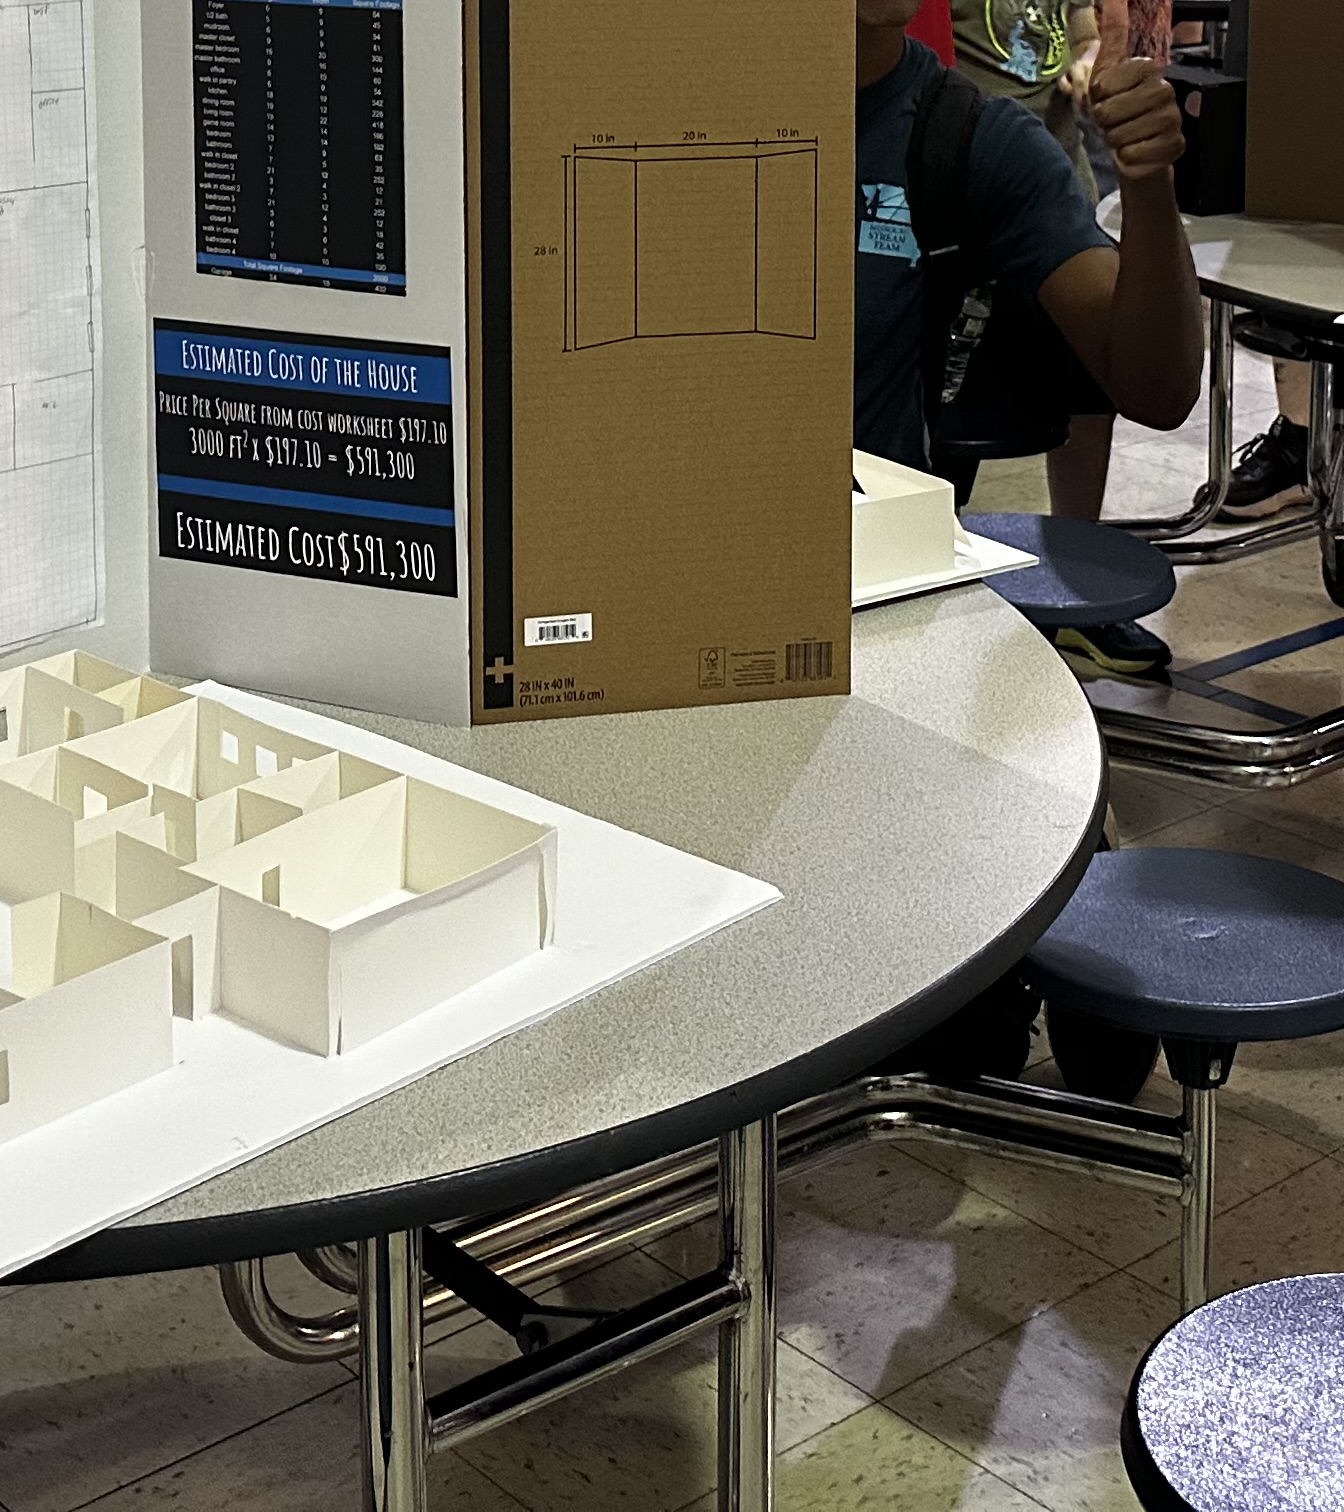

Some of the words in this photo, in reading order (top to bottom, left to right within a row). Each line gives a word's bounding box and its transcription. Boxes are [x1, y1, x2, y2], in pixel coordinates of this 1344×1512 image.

[591, 133, 604, 144] 10
[606, 133, 615, 144] in
[683, 131, 695, 141] 20
[697, 130, 707, 140] in
[776, 128, 788, 138] 10
[790, 128, 799, 138] in
[534, 246, 547, 256] 28
[549, 245, 558, 256] in
[181, 339, 262, 377] ESTIMATED
[268, 348, 304, 382] COST
[310, 356, 329, 384] OF
[334, 358, 361, 388] THE
[368, 360, 418, 393] HOUSE
[159, 390, 188, 416] PRICE
[192, 394, 211, 419] PER
[215, 397, 257, 426] SQUARE
[261, 405, 294, 429] FROM
[298, 409, 323, 431] COST
[327, 412, 394, 439] WORKSHEET
[399, 417, 447, 445] $197.10
[189, 427, 224, 457] 3000
[265, 436, 322, 469] $197.10
[346, 445, 415, 480] $591,300
[176, 512, 280, 562] ESTIMATED
[519, 681, 530, 693] 28
[532, 679, 542, 692] IN
[544, 681, 550, 691] x
[551, 678, 563, 690] 40
[564, 677, 575, 689] IN
[519, 692, 539, 708] (71.1
[541, 695, 554, 705] cm
[556, 693, 561, 703] x
[563, 690, 585, 704] 101.6
[586, 688, 605, 703] cm)
